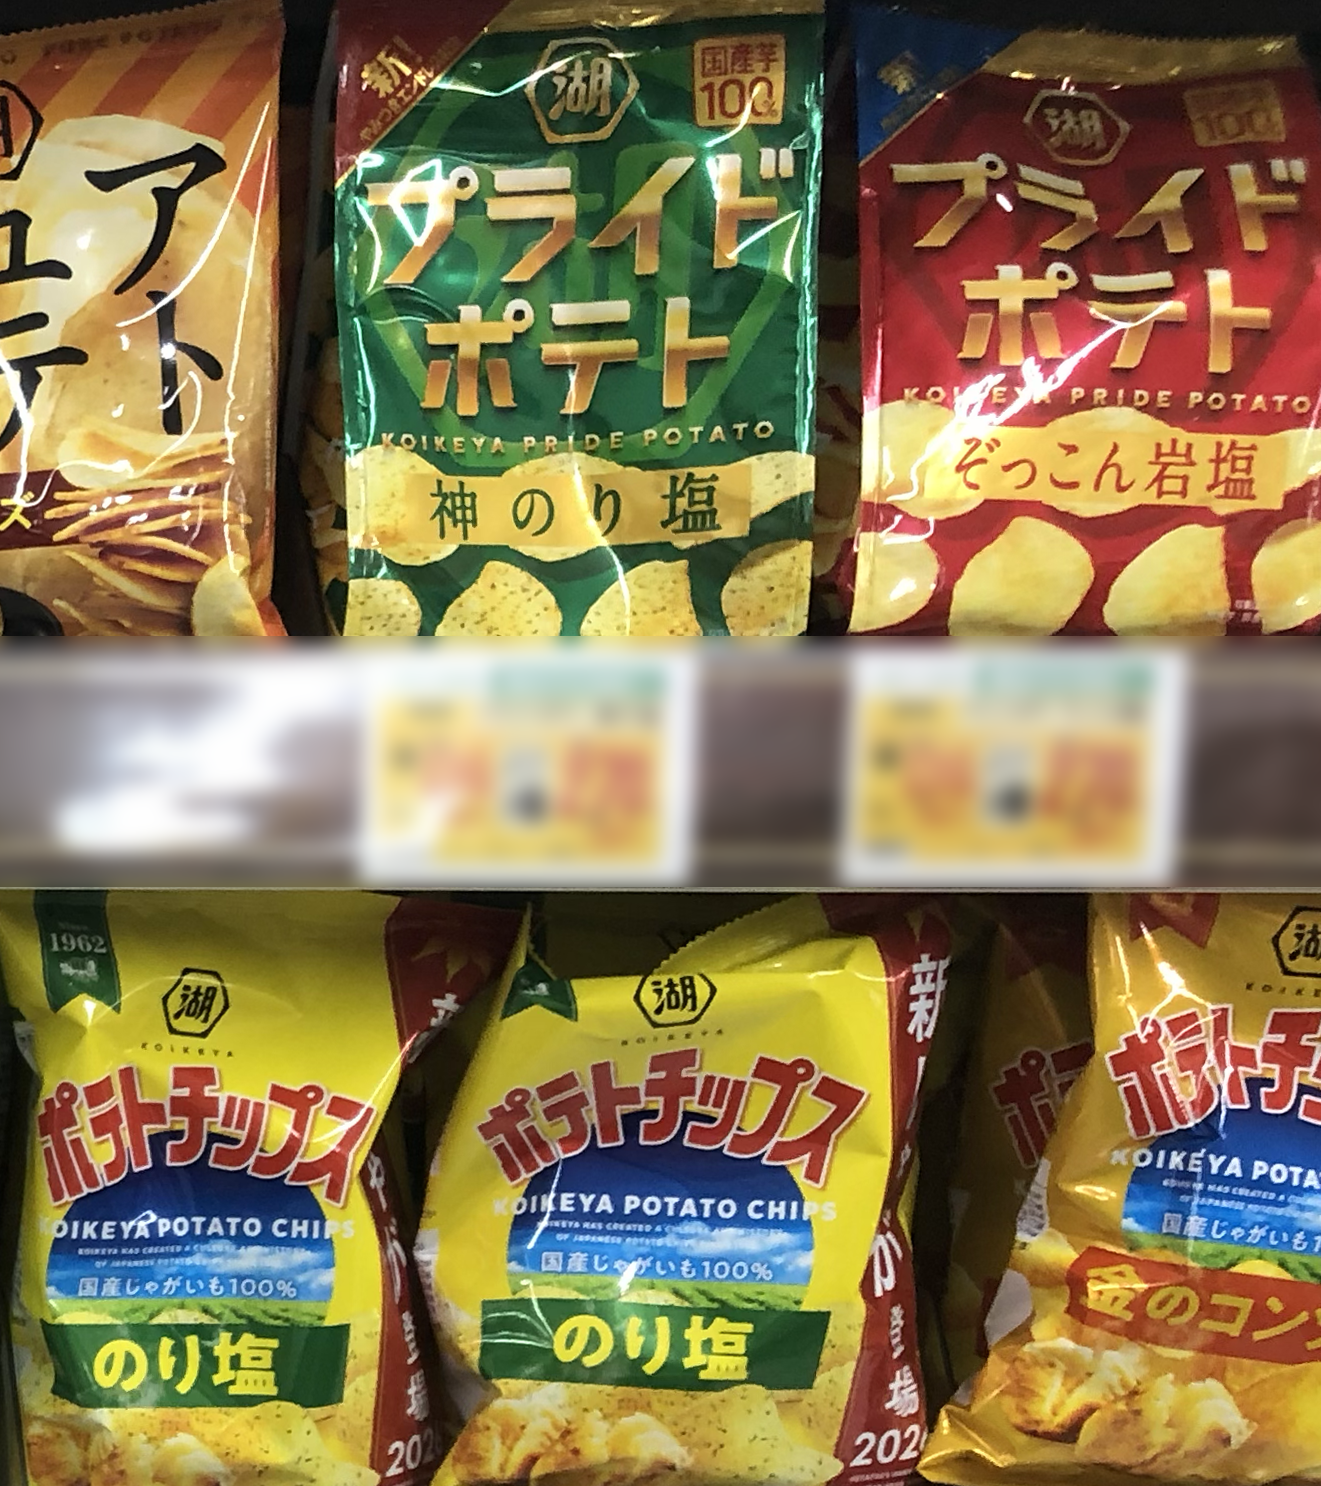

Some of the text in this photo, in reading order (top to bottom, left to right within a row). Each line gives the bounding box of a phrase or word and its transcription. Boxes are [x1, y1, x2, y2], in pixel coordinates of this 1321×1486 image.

[700, 41, 783, 77] 国産芋
[366, 149, 794, 284] プライド
[890, 152, 1308, 254] プライド
[957, 262, 1271, 374] ポテト
[420, 297, 730, 416] ポテト
[1071, 386, 1311, 416] PRIDE POTATO
[381, 420, 775, 455] KOIKEYA PRIDE POTATO
[956, 437, 1259, 501] ぞっこん岩塩
[429, 473, 723, 541] 神のり塩
[49, 932, 108, 954] 1962
[38, 1066, 374, 1208] ポテトチップス
[478, 1049, 868, 1188] ポテトチップス
[1110, 1147, 1243, 1178] KOIKEYA
[157, 1216, 262, 1239] POTATO
[272, 1217, 356, 1241] CHIPS
[493, 1192, 837, 1222] KOIKEYA POTATO CHIPS
[78, 1275, 297, 1299] 国産じゃがいも100%
[540, 1252, 773, 1281] 国産じゃがいも100%
[94, 1333, 279, 1397] のり塩
[553, 1315, 755, 1380] のり塩
